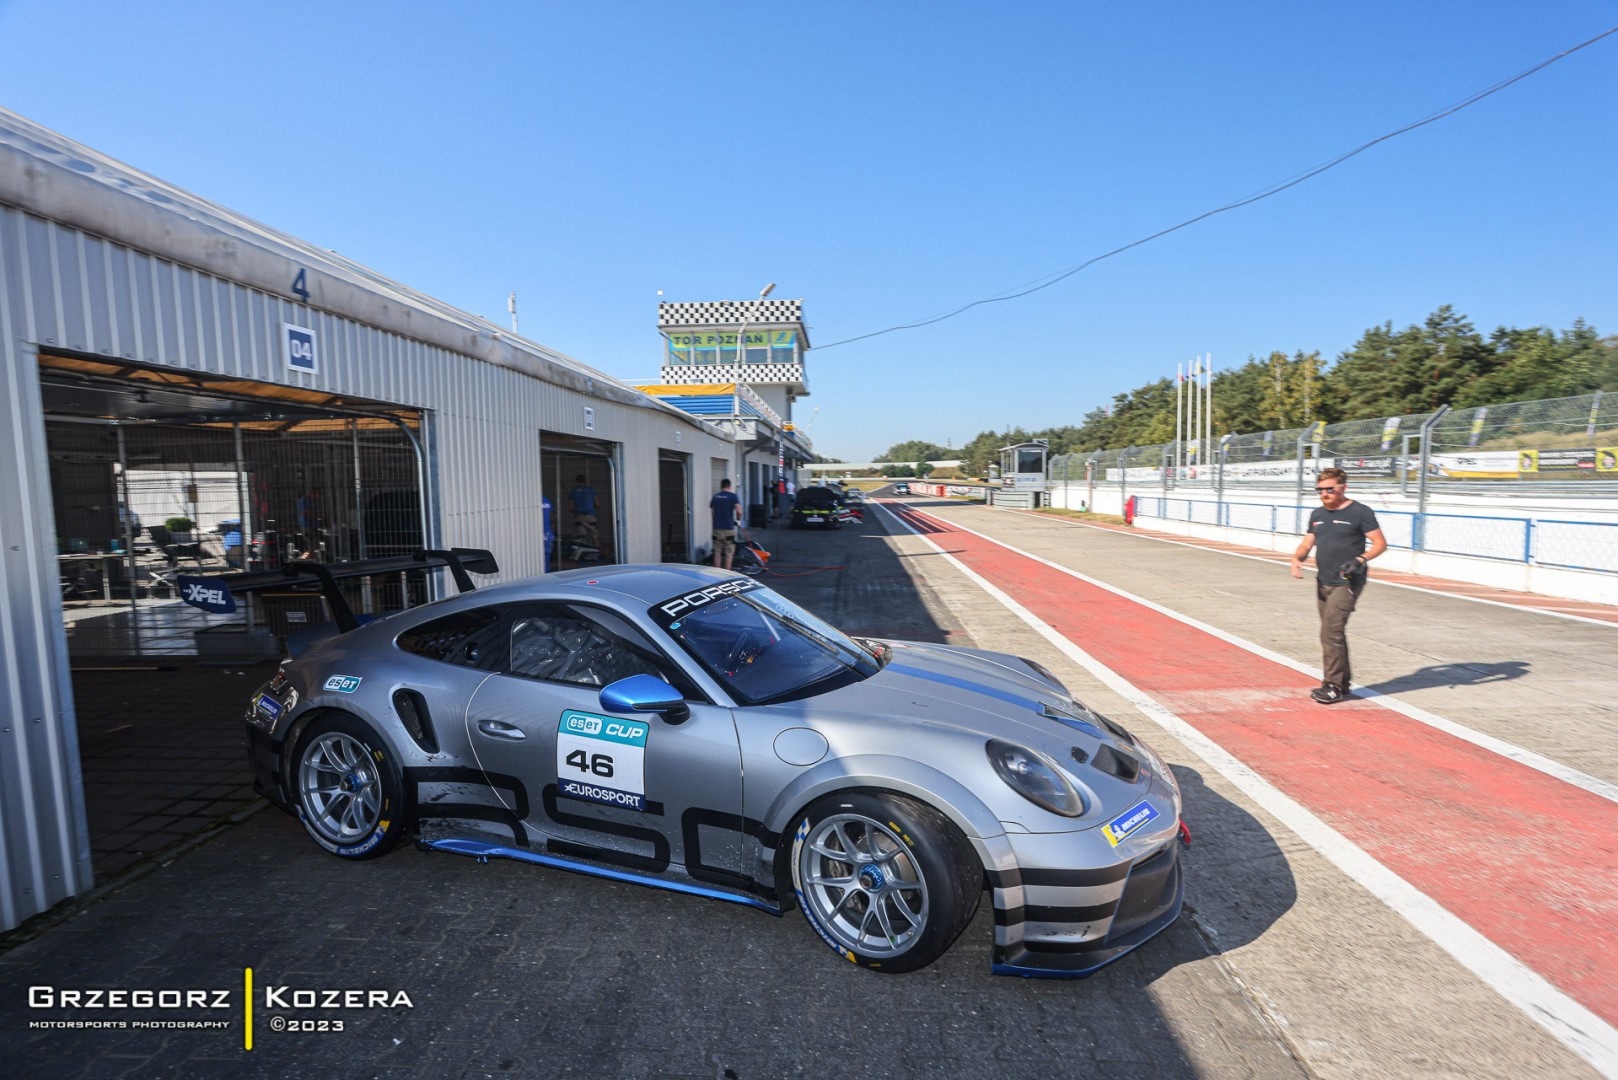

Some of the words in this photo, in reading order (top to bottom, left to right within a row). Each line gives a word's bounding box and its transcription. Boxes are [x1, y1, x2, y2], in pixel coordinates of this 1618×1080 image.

[292, 268, 311, 303] 4
[290, 339, 312, 361] 04
[673, 335, 702, 345] TOR
[188, 584, 226, 605] XPEL
[606, 724, 643, 738] CUP
[566, 750, 614, 778] 46
[567, 784, 640, 807] EUROSPORT
[1121, 808, 1151, 831] MICHELIN
